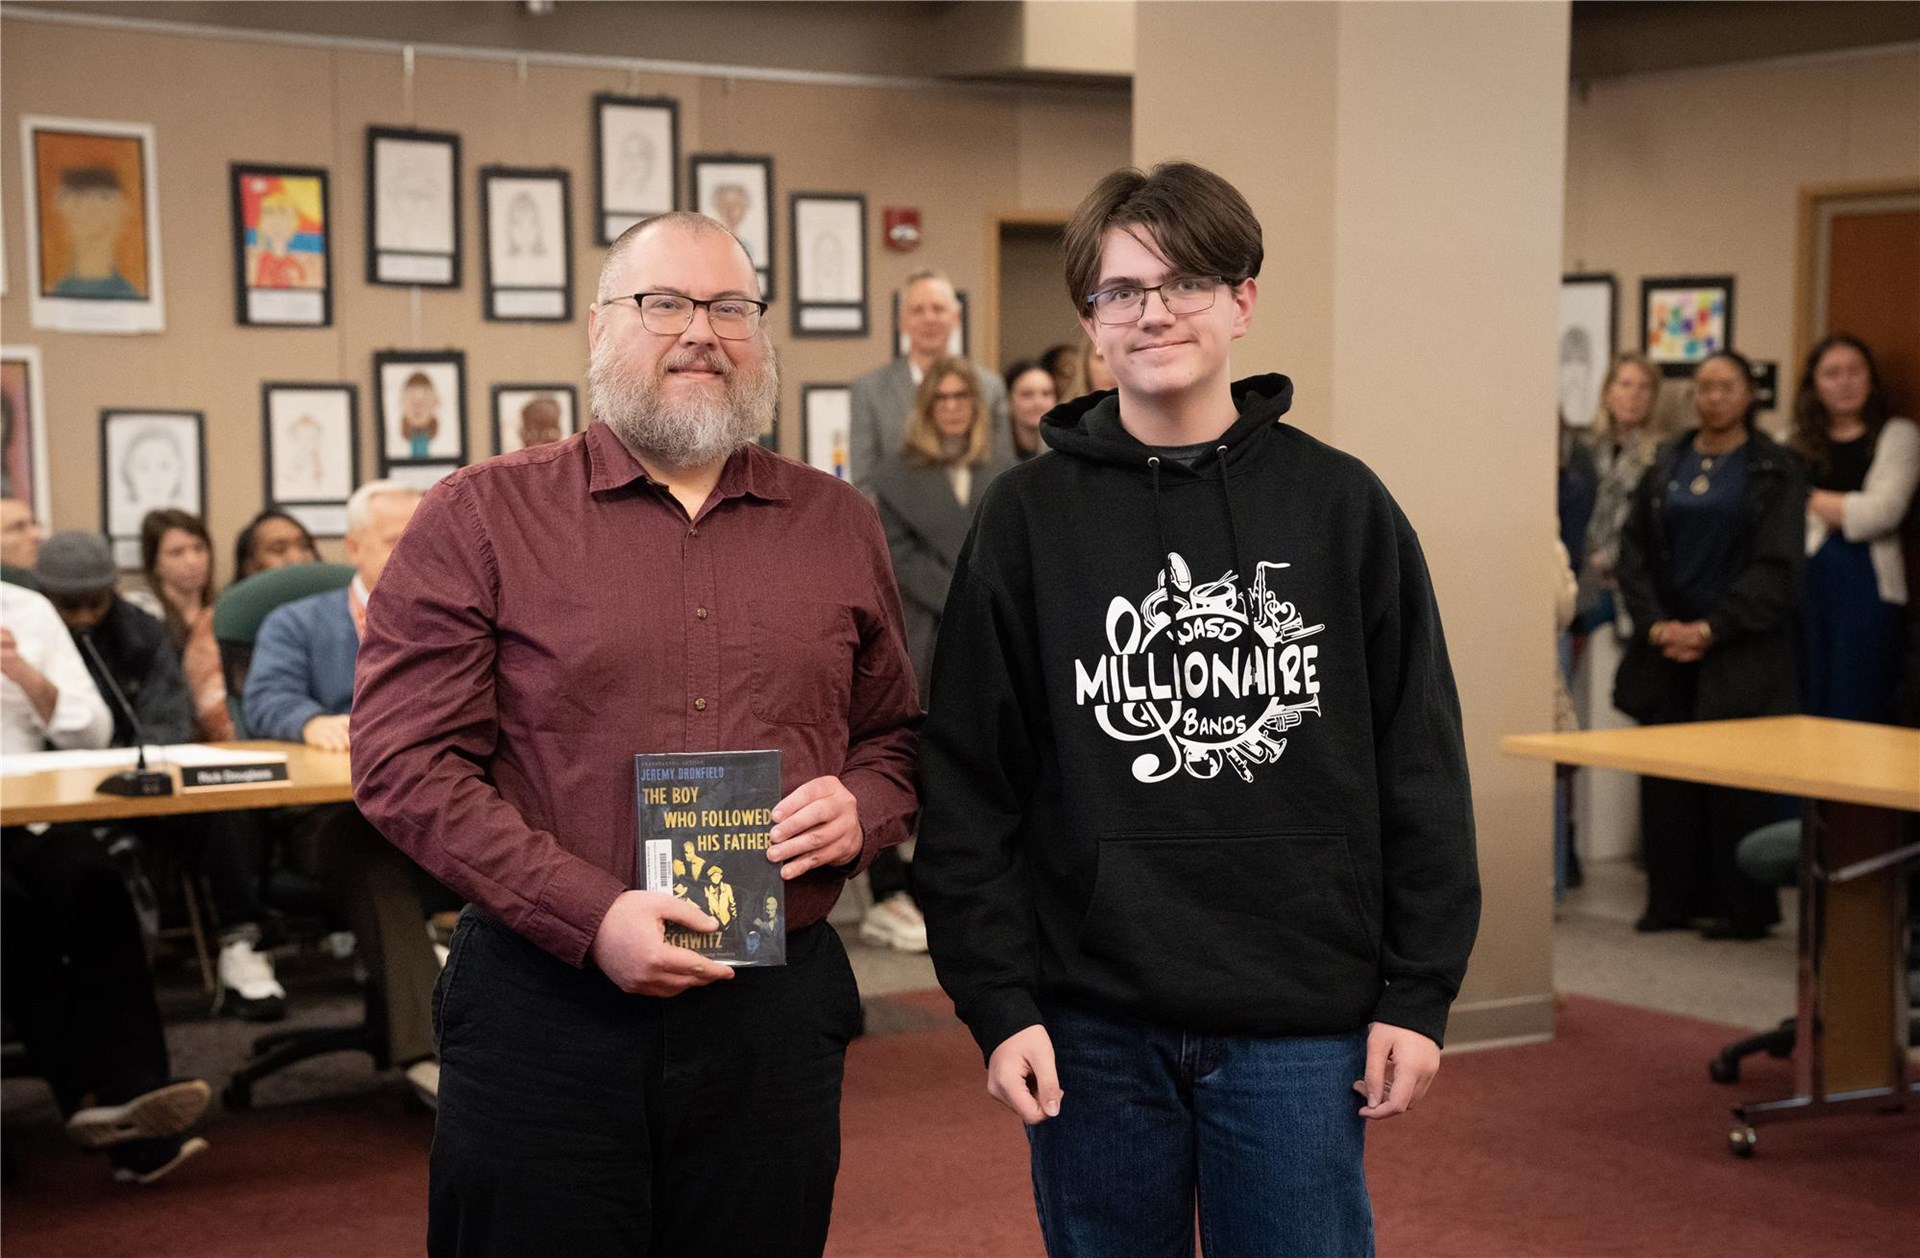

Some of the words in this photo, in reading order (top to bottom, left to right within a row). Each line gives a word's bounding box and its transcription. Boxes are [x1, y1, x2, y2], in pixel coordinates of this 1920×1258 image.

[1166, 617, 1243, 646] WASD
[1075, 644, 1320, 705] MILLIONAIRE
[1183, 708, 1247, 736] BANDS
[640, 767, 675, 781] JEREMY
[678, 766, 725, 780] DRONFIELD
[642, 787, 667, 805] THE
[672, 786, 699, 804] BOY
[664, 811, 697, 828] WHO
[701, 808, 772, 827] FOLLOWED
[697, 834, 720, 851] HIS
[724, 833, 772, 851] FATHER
